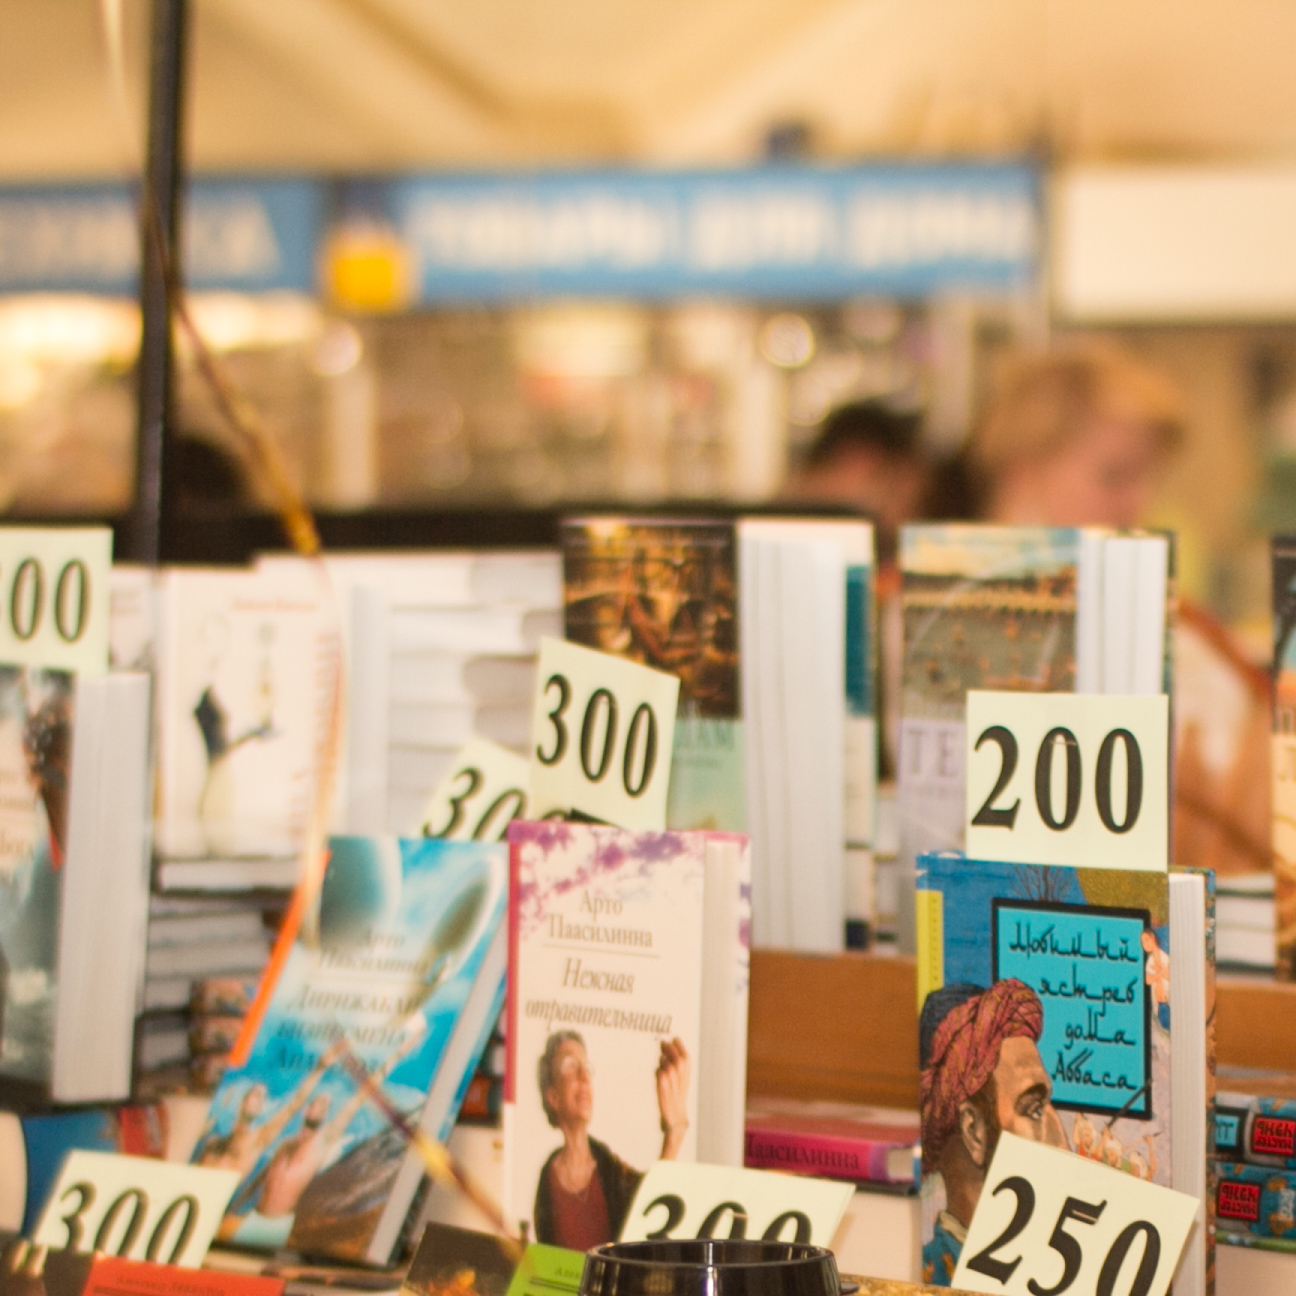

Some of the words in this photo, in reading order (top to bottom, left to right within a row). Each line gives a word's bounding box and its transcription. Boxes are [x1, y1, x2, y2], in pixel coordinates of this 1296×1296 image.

[536, 673, 659, 798] 300
[971, 725, 1144, 833] 200
[580, 889, 624, 922] Арто
[549, 912, 653, 948] Паасилинна
[1009, 921, 1139, 963] Любимый
[562, 957, 635, 994] Нежная
[1038, 962, 1139, 1018] ястреб
[525, 998, 673, 1035] отравительница
[1064, 1006, 1138, 1051] дома
[1050, 1047, 1138, 1090] Аббаса
[53, 1180, 201, 1267] 300
